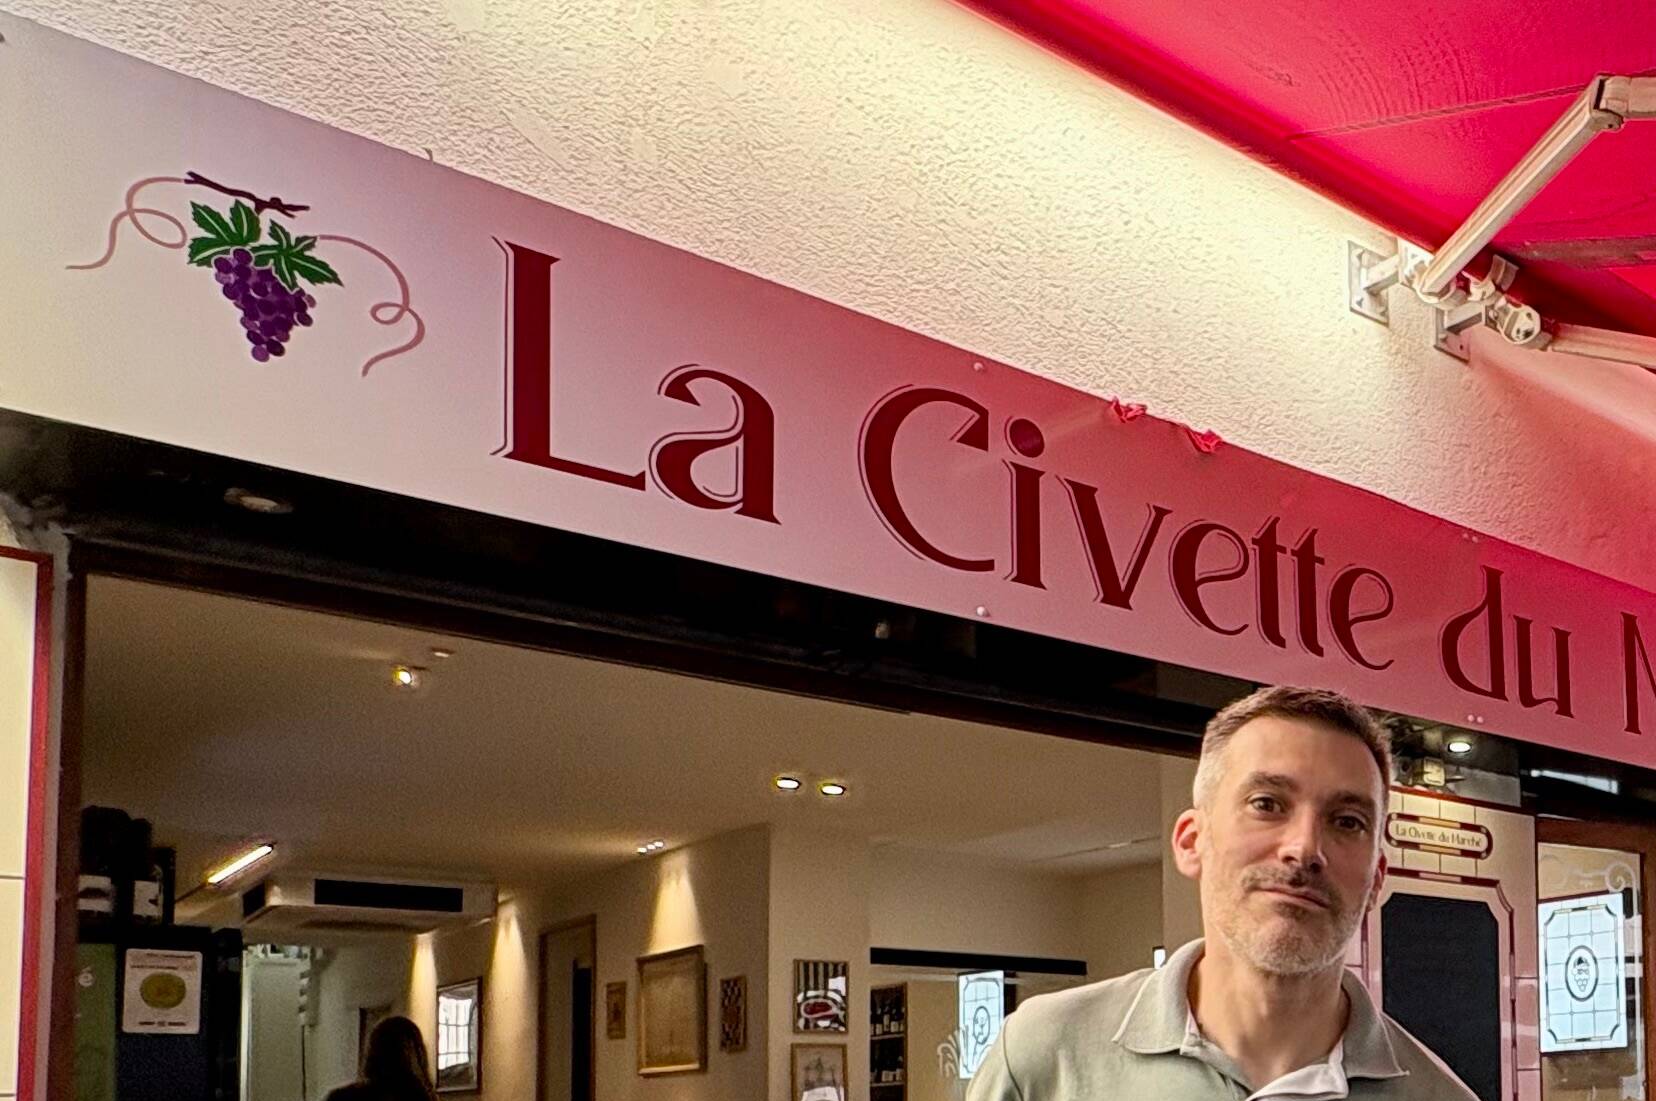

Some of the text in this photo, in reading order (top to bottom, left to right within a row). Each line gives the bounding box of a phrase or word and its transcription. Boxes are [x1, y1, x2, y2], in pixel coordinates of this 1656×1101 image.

[490, 234, 782, 526] La
[858, 383, 1396, 672] Civette
[1440, 564, 1575, 720] du
